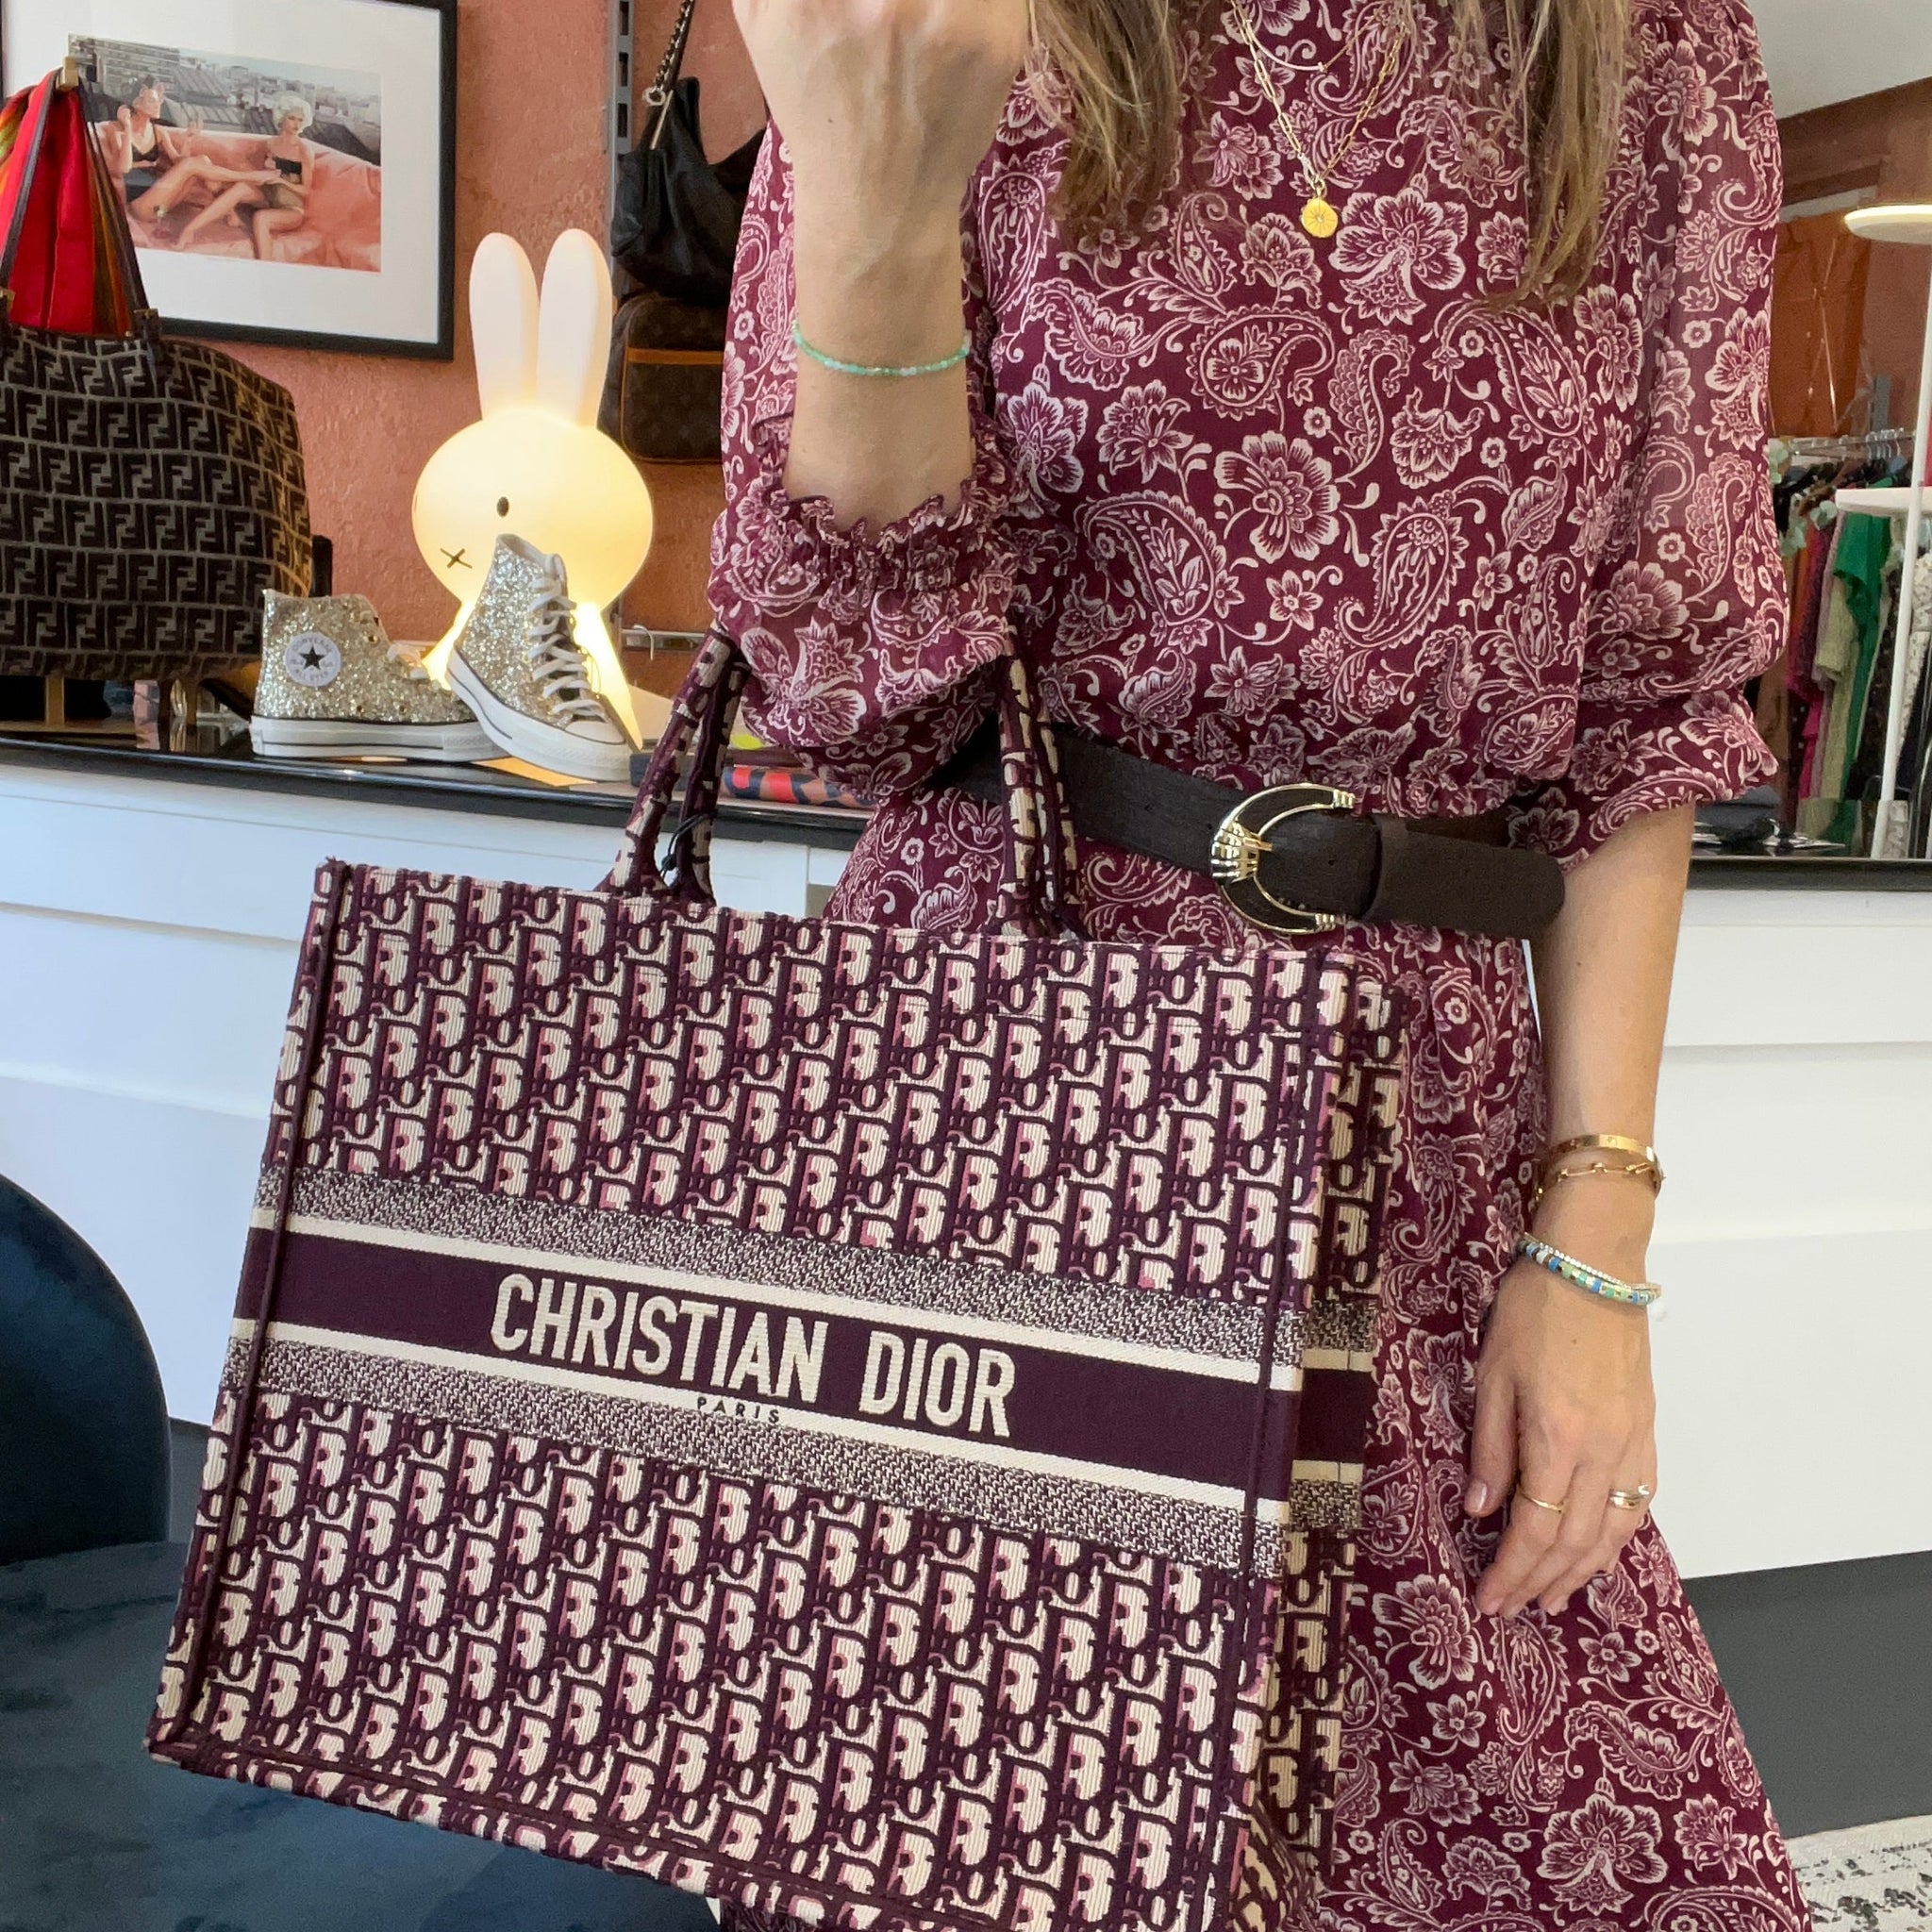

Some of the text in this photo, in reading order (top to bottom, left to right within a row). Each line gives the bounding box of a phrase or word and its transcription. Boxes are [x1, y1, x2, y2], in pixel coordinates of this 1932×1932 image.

[490, 1273, 1016, 1437] CHRISTIAN DIOR
[697, 1396, 780, 1424] PARIS
